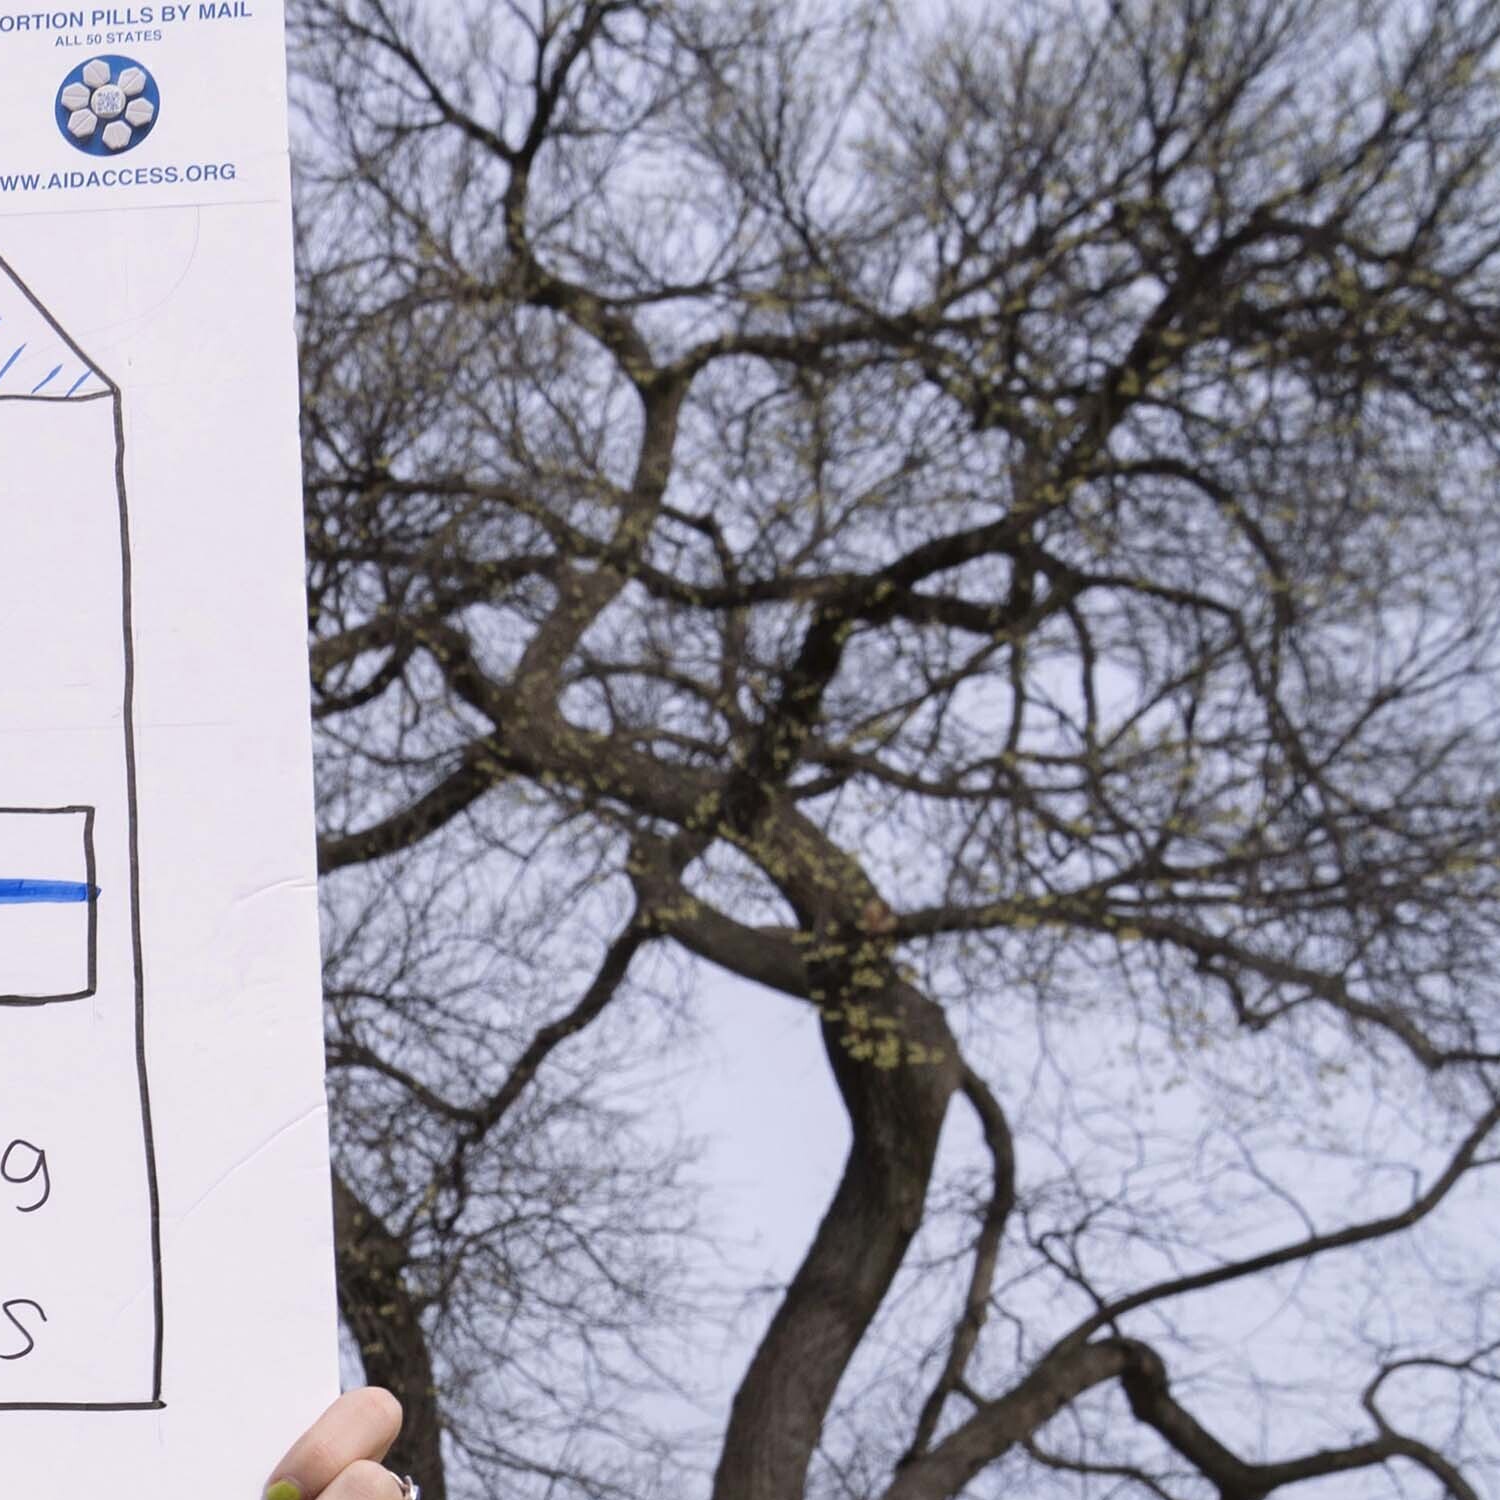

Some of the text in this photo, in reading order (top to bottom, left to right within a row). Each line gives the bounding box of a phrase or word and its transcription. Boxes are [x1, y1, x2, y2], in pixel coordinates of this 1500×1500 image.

[91, 7, 154, 27] PILLS
[161, 5, 192, 22] BY
[198, 1, 253, 20] MAIL
[54, 29, 164, 47] ALL 50 STATES
